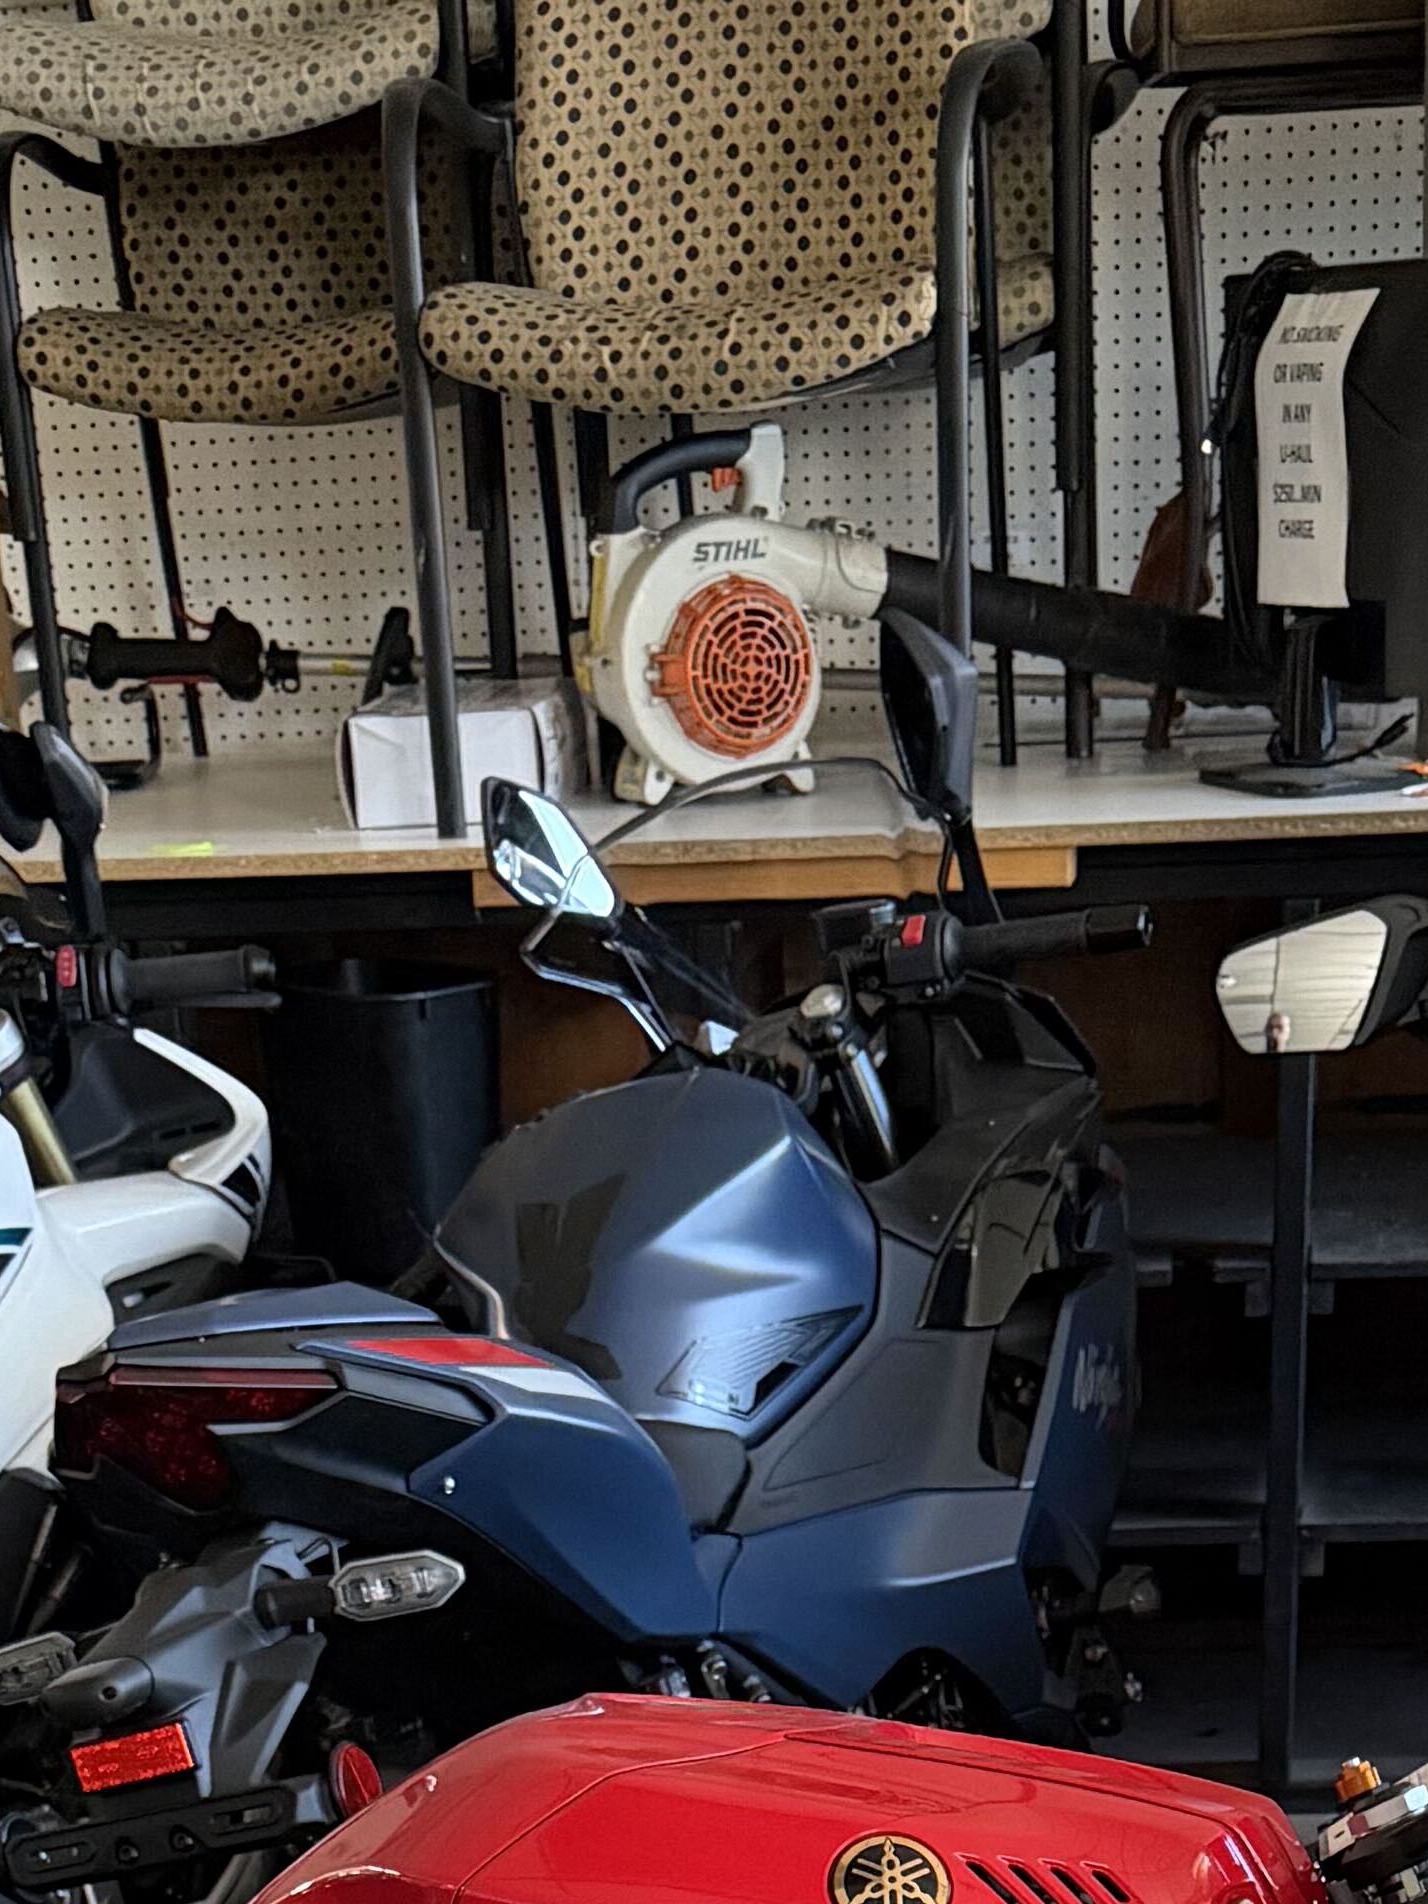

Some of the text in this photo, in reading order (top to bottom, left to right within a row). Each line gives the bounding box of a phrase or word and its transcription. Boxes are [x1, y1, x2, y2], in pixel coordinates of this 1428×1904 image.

[1282, 403, 1312, 424] IN ANY
[1278, 519, 1315, 539] CHARGE
[693, 538, 766, 562] STIHL
